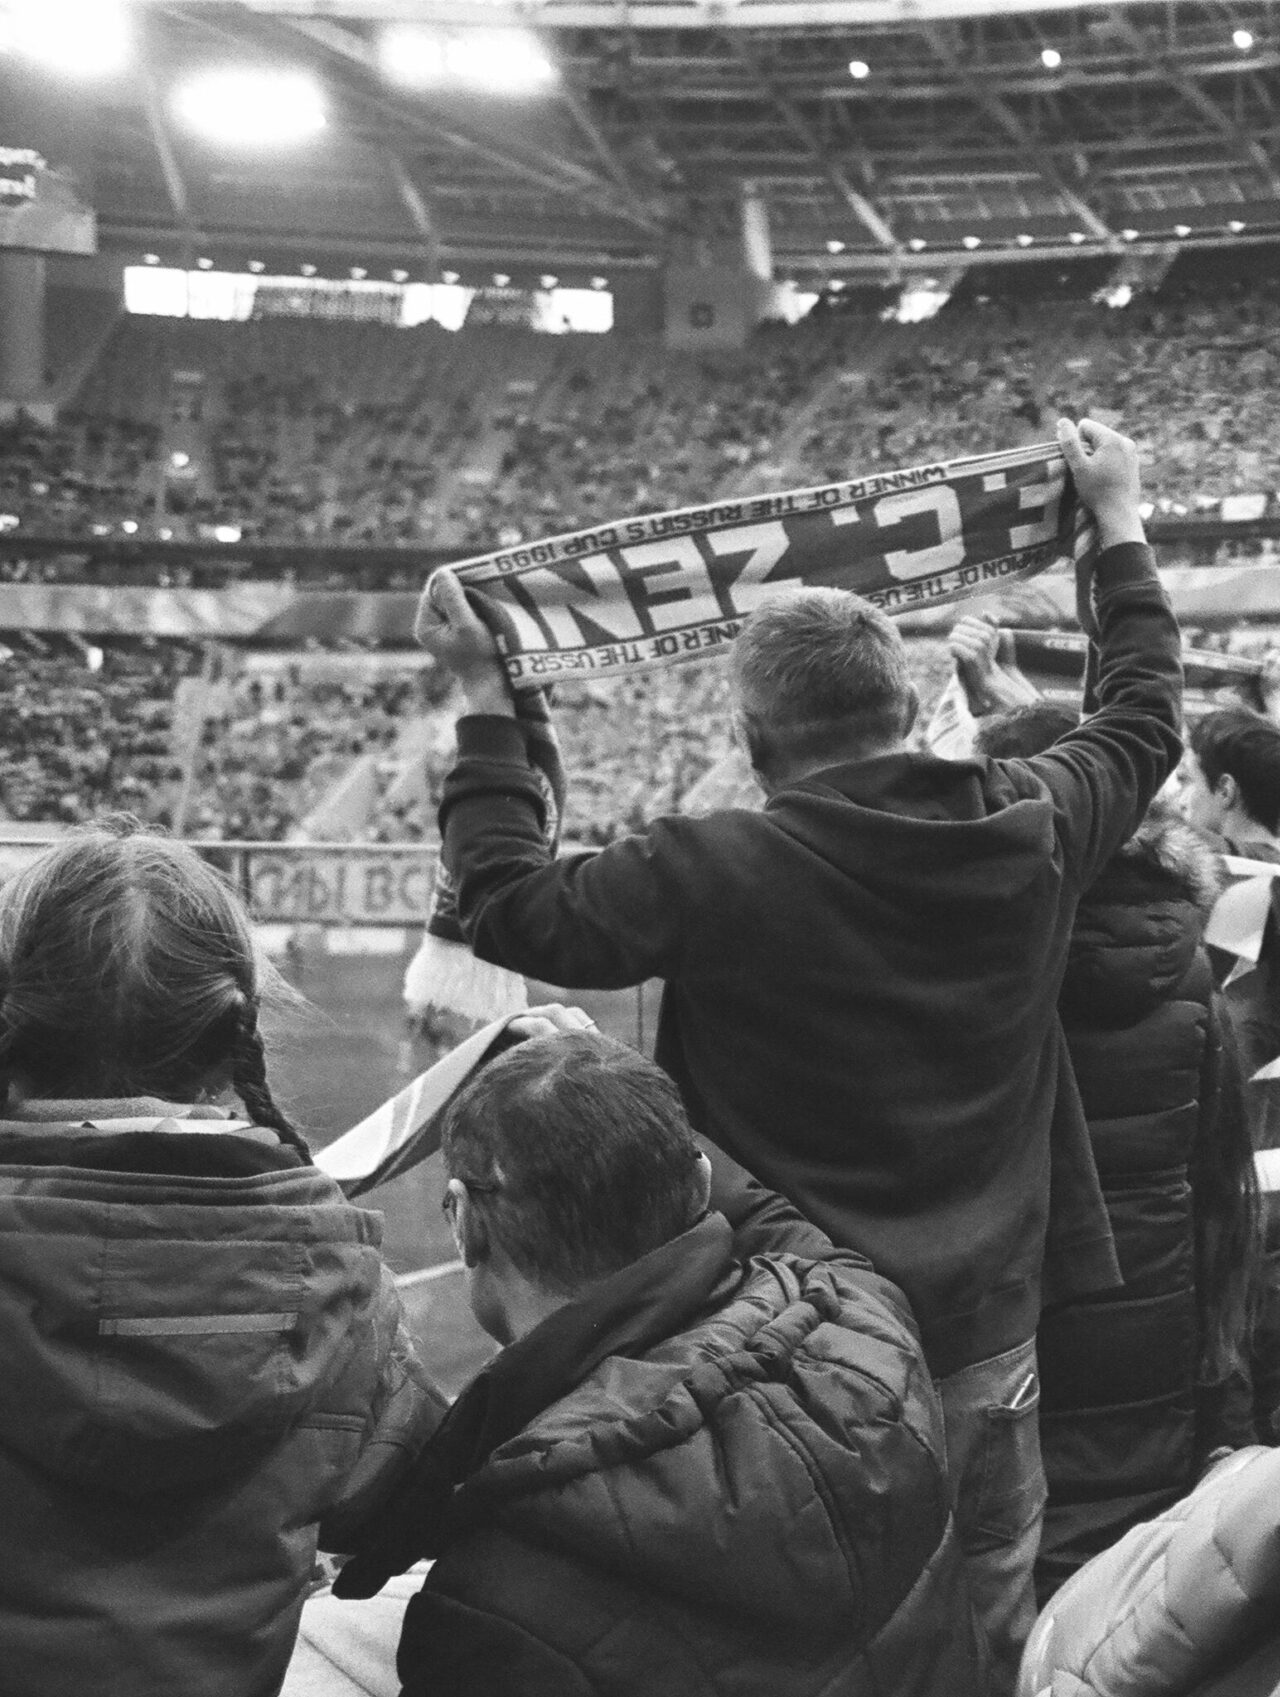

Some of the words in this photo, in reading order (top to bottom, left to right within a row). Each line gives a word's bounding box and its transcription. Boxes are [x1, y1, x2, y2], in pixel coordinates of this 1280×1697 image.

[848, 465, 946, 500] WINNER
[752, 496, 797, 516] THE
[808, 488, 841, 508] OF
[564, 528, 619, 554] CUP
[496, 543, 558, 573] 1999
[494, 520, 803, 653] ZENI
[904, 576, 951, 602] THE
[953, 565, 980, 591] OF
[869, 588, 901, 609] US
[600, 644, 646, 668] THE
[650, 632, 680, 659] OF
[531, 651, 596, 675] USSR
